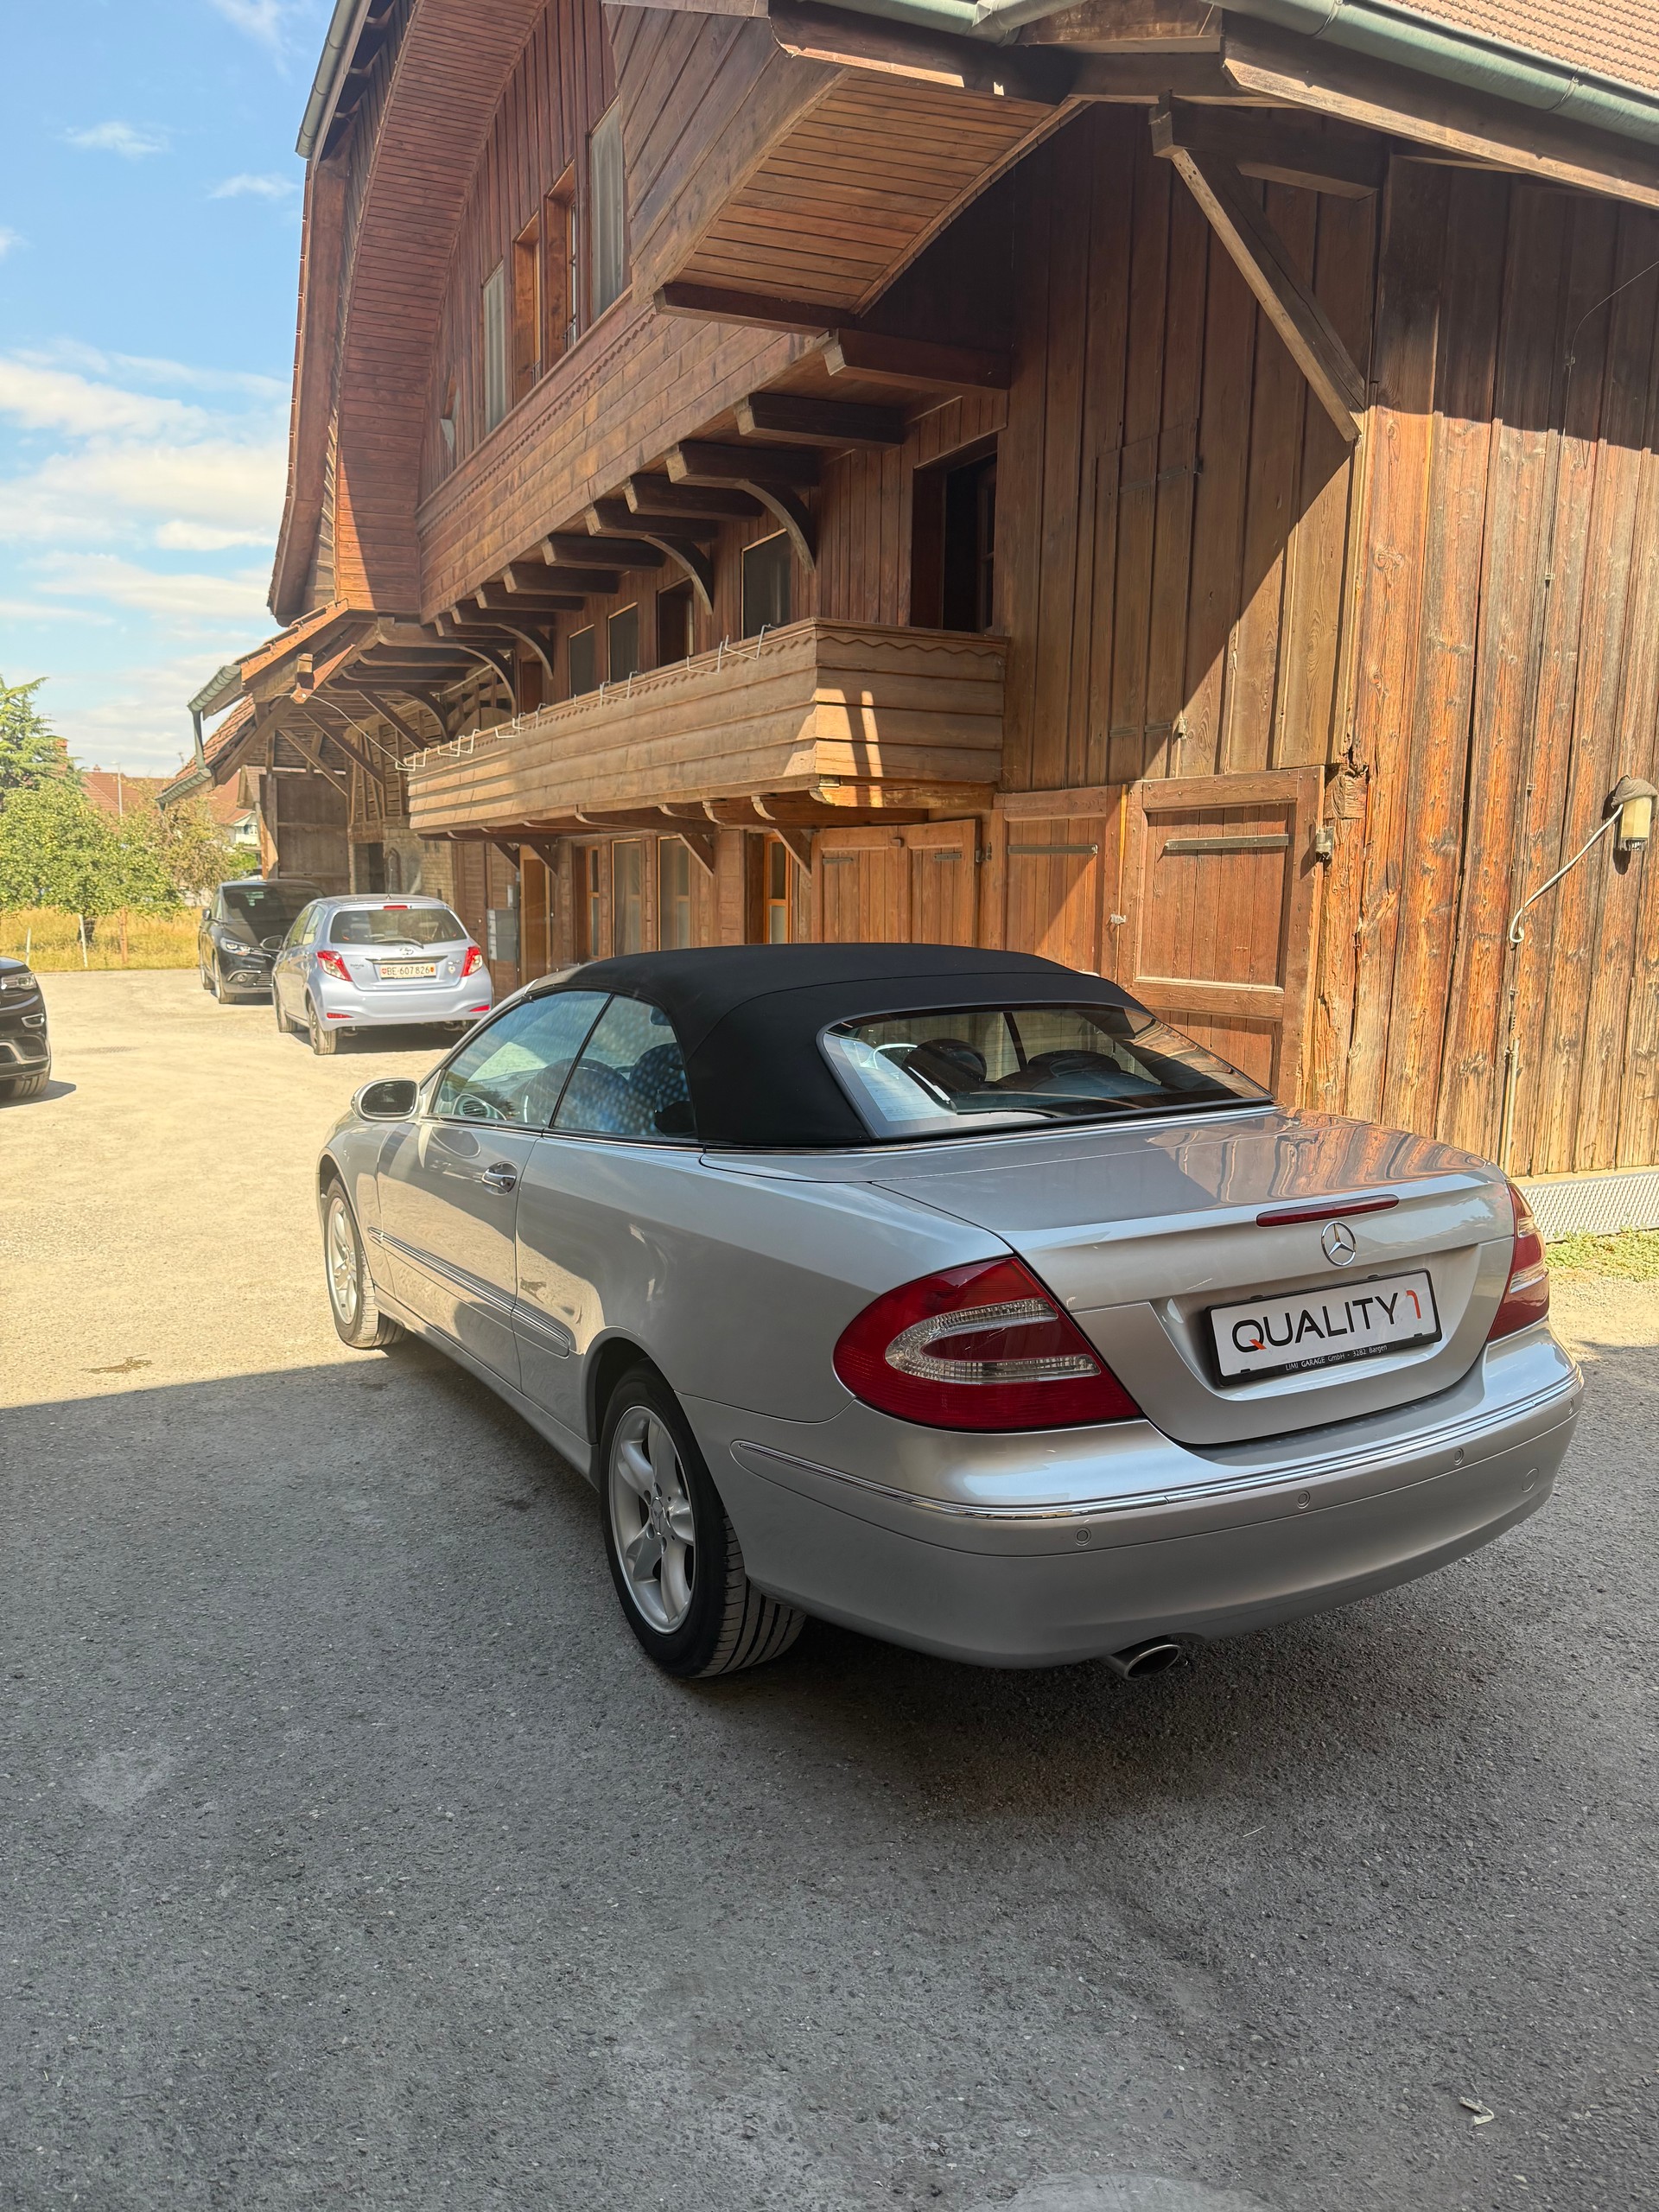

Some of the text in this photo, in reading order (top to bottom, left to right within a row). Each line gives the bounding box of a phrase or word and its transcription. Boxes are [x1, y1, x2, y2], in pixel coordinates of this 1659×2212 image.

[1300, 1357, 1325, 1367] GARAGE
[1352, 1348, 1367, 1357] 3282
[1369, 1344, 1388, 1354] Bargen
